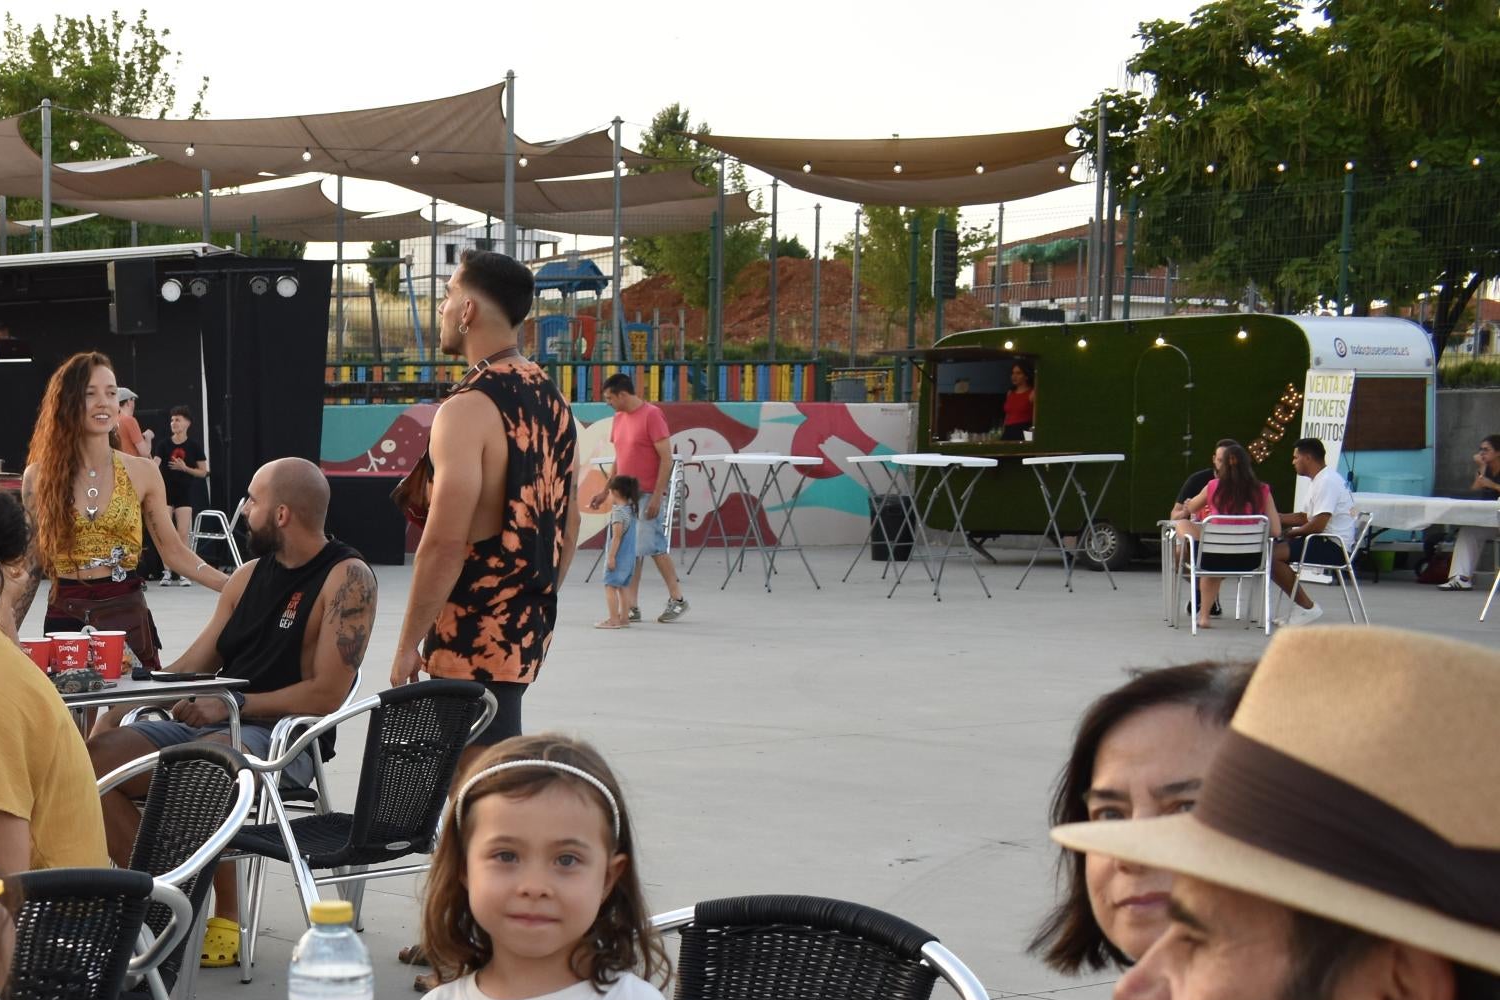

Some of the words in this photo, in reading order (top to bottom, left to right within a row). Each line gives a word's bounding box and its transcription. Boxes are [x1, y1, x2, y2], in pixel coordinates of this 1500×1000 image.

[1308, 376, 1338, 393] VENTA
[1341, 376, 1353, 393] DE
[1307, 399, 1346, 418] TICKETS
[1303, 421, 1344, 441] MOJITOS
